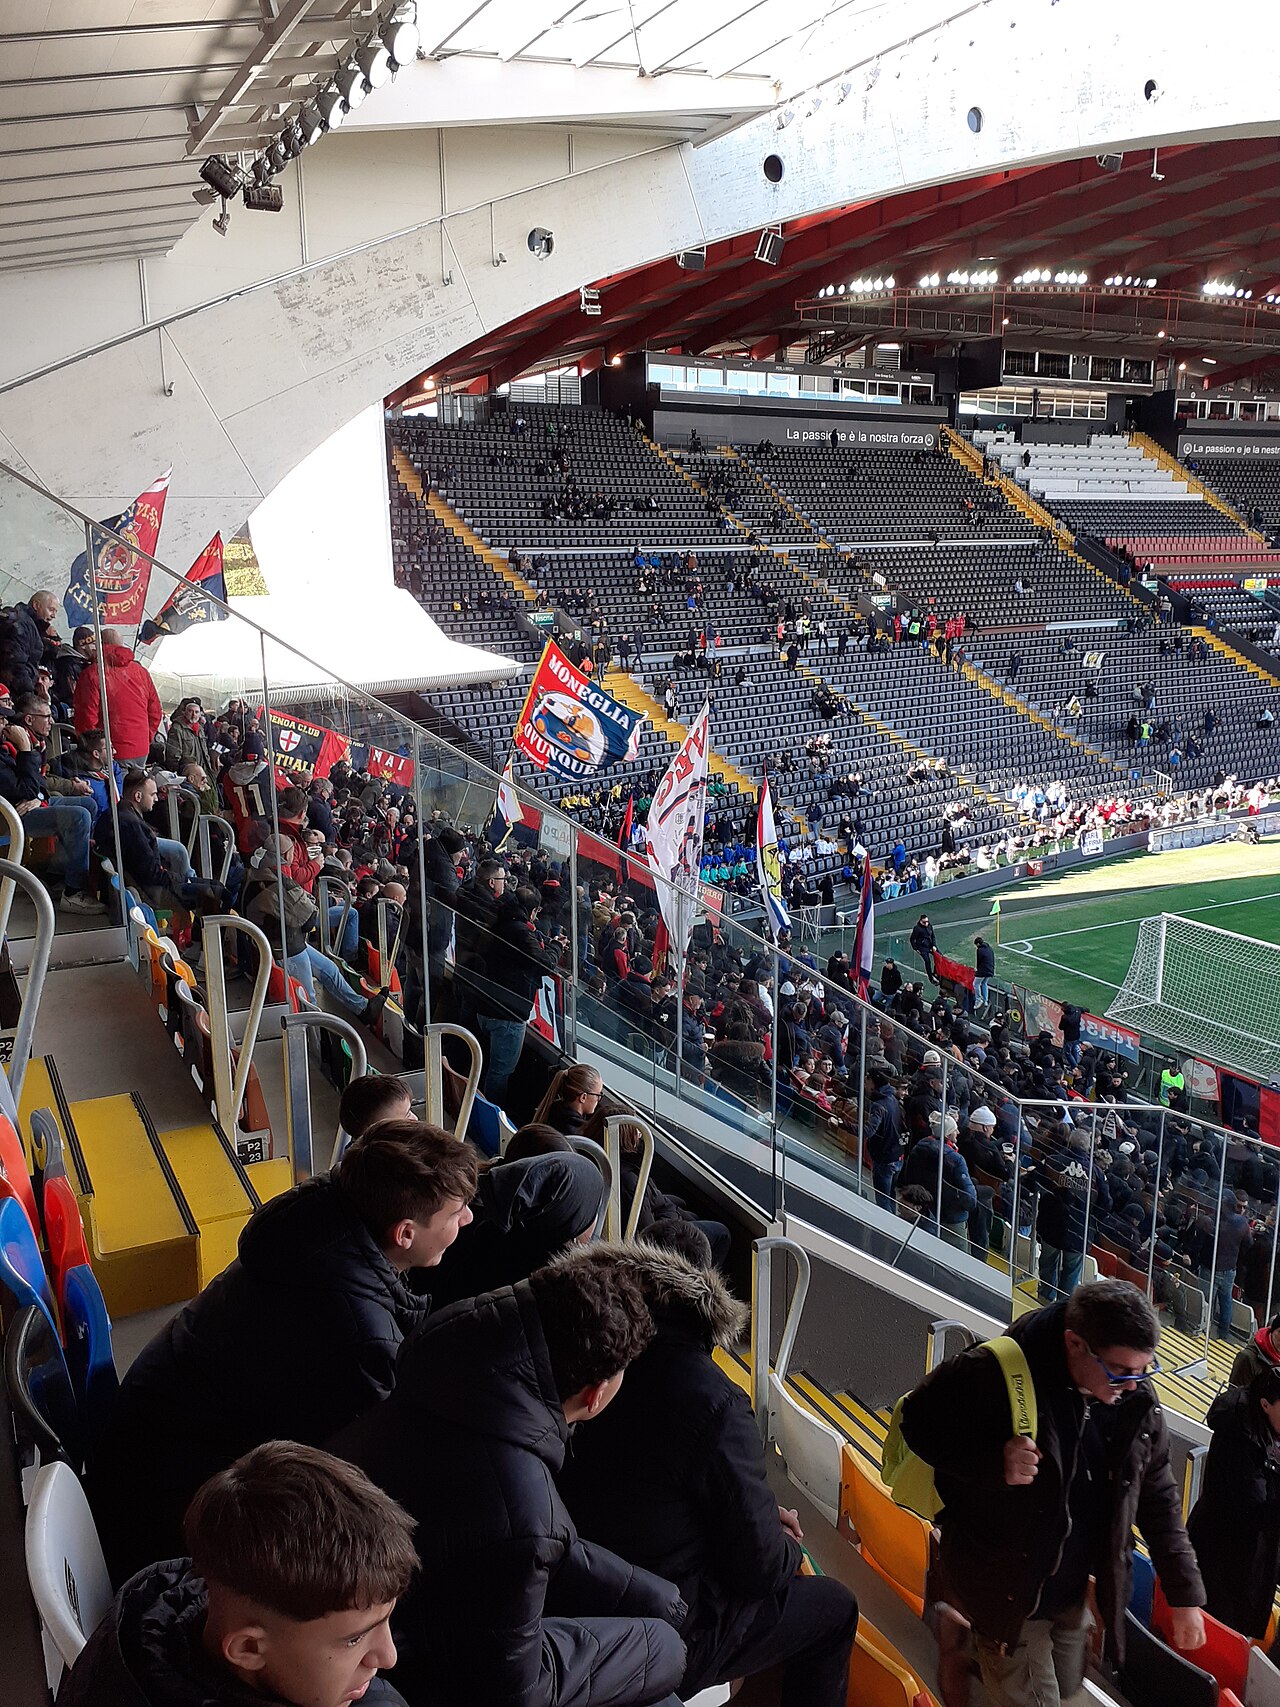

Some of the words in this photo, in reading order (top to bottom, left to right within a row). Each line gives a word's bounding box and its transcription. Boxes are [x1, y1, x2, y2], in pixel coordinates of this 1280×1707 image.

[786, 428, 800, 440] La
[848, 430, 856, 442] è
[858, 431, 867, 442] la
[869, 433, 899, 443] nostra
[901, 433, 924, 444] forza
[1193, 443, 1204, 453] La
[1205, 444, 1235, 455] passion
[1252, 445, 1260, 454] la
[548, 653, 631, 731] MONEGLIA
[297, 723, 320, 738] CLUB
[523, 722, 598, 775] OVUNQUE
[233, 783, 266, 817] 11
[247, 1141, 261, 1152] P2
[249, 1152, 262, 1162] 23
